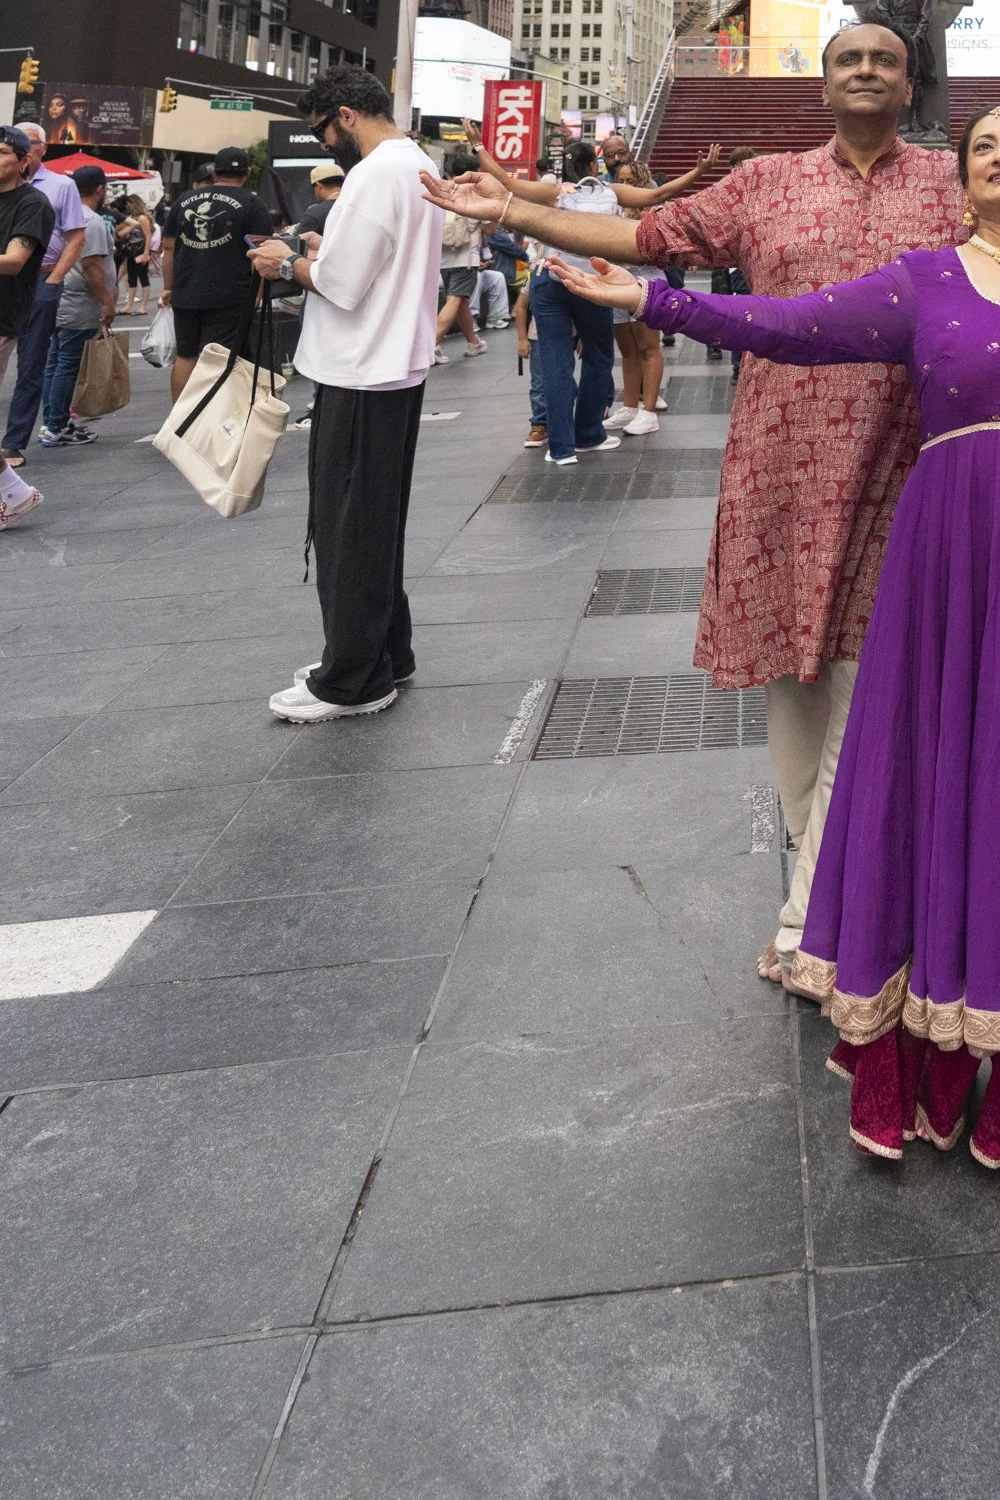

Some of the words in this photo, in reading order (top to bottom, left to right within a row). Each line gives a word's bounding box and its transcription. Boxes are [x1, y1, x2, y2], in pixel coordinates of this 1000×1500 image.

[495, 85, 533, 160] tkts
[180, 192, 212, 208] OUTLAW
[212, 192, 243, 210] COUNTRY
[209, 232, 233, 247] SPIRIT
